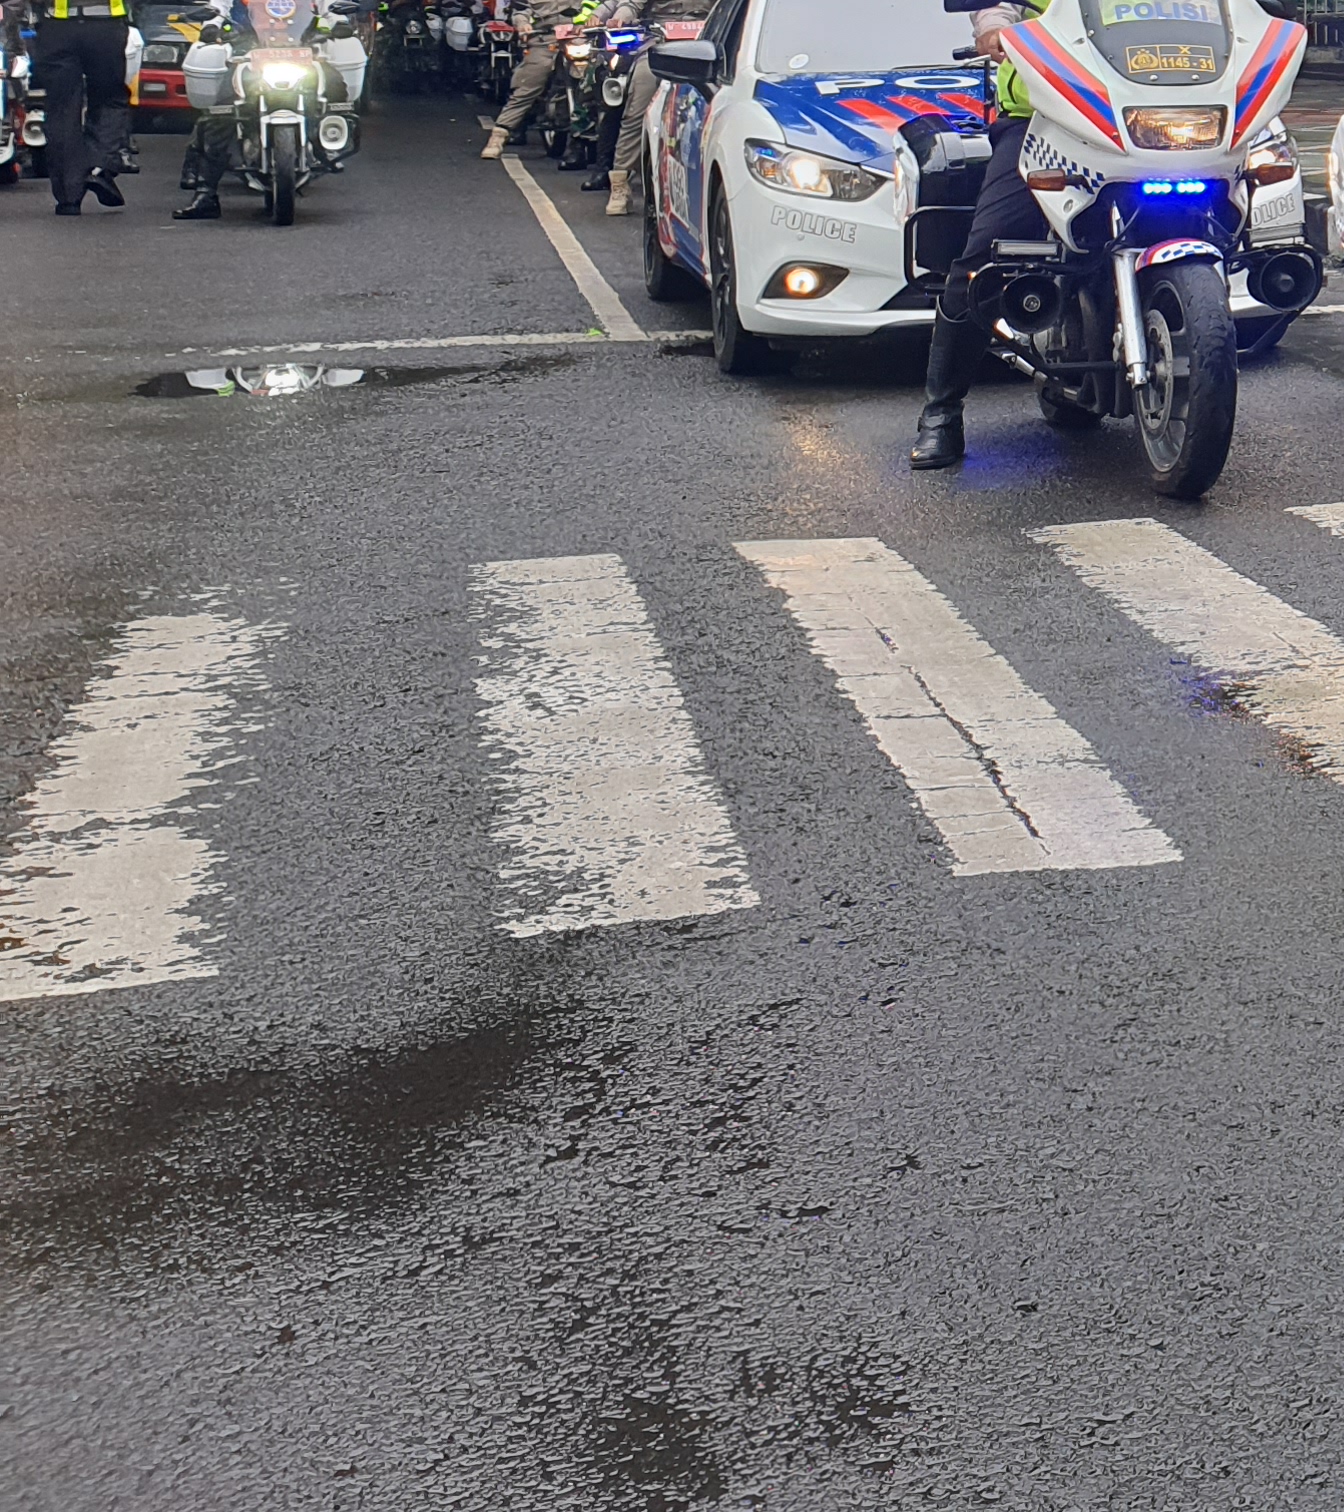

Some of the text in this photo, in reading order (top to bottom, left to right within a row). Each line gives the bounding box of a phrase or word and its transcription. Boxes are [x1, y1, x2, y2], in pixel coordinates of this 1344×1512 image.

[1114, 1, 1209, 21] POLISI
[1179, 46, 1191, 54] X
[1161, 56, 1190, 68] 1145
[1199, 58, 1214, 70] 31
[814, 75, 981, 96] PO
[1251, 192, 1297, 227] OLICE
[770, 205, 858, 244] POLICE
